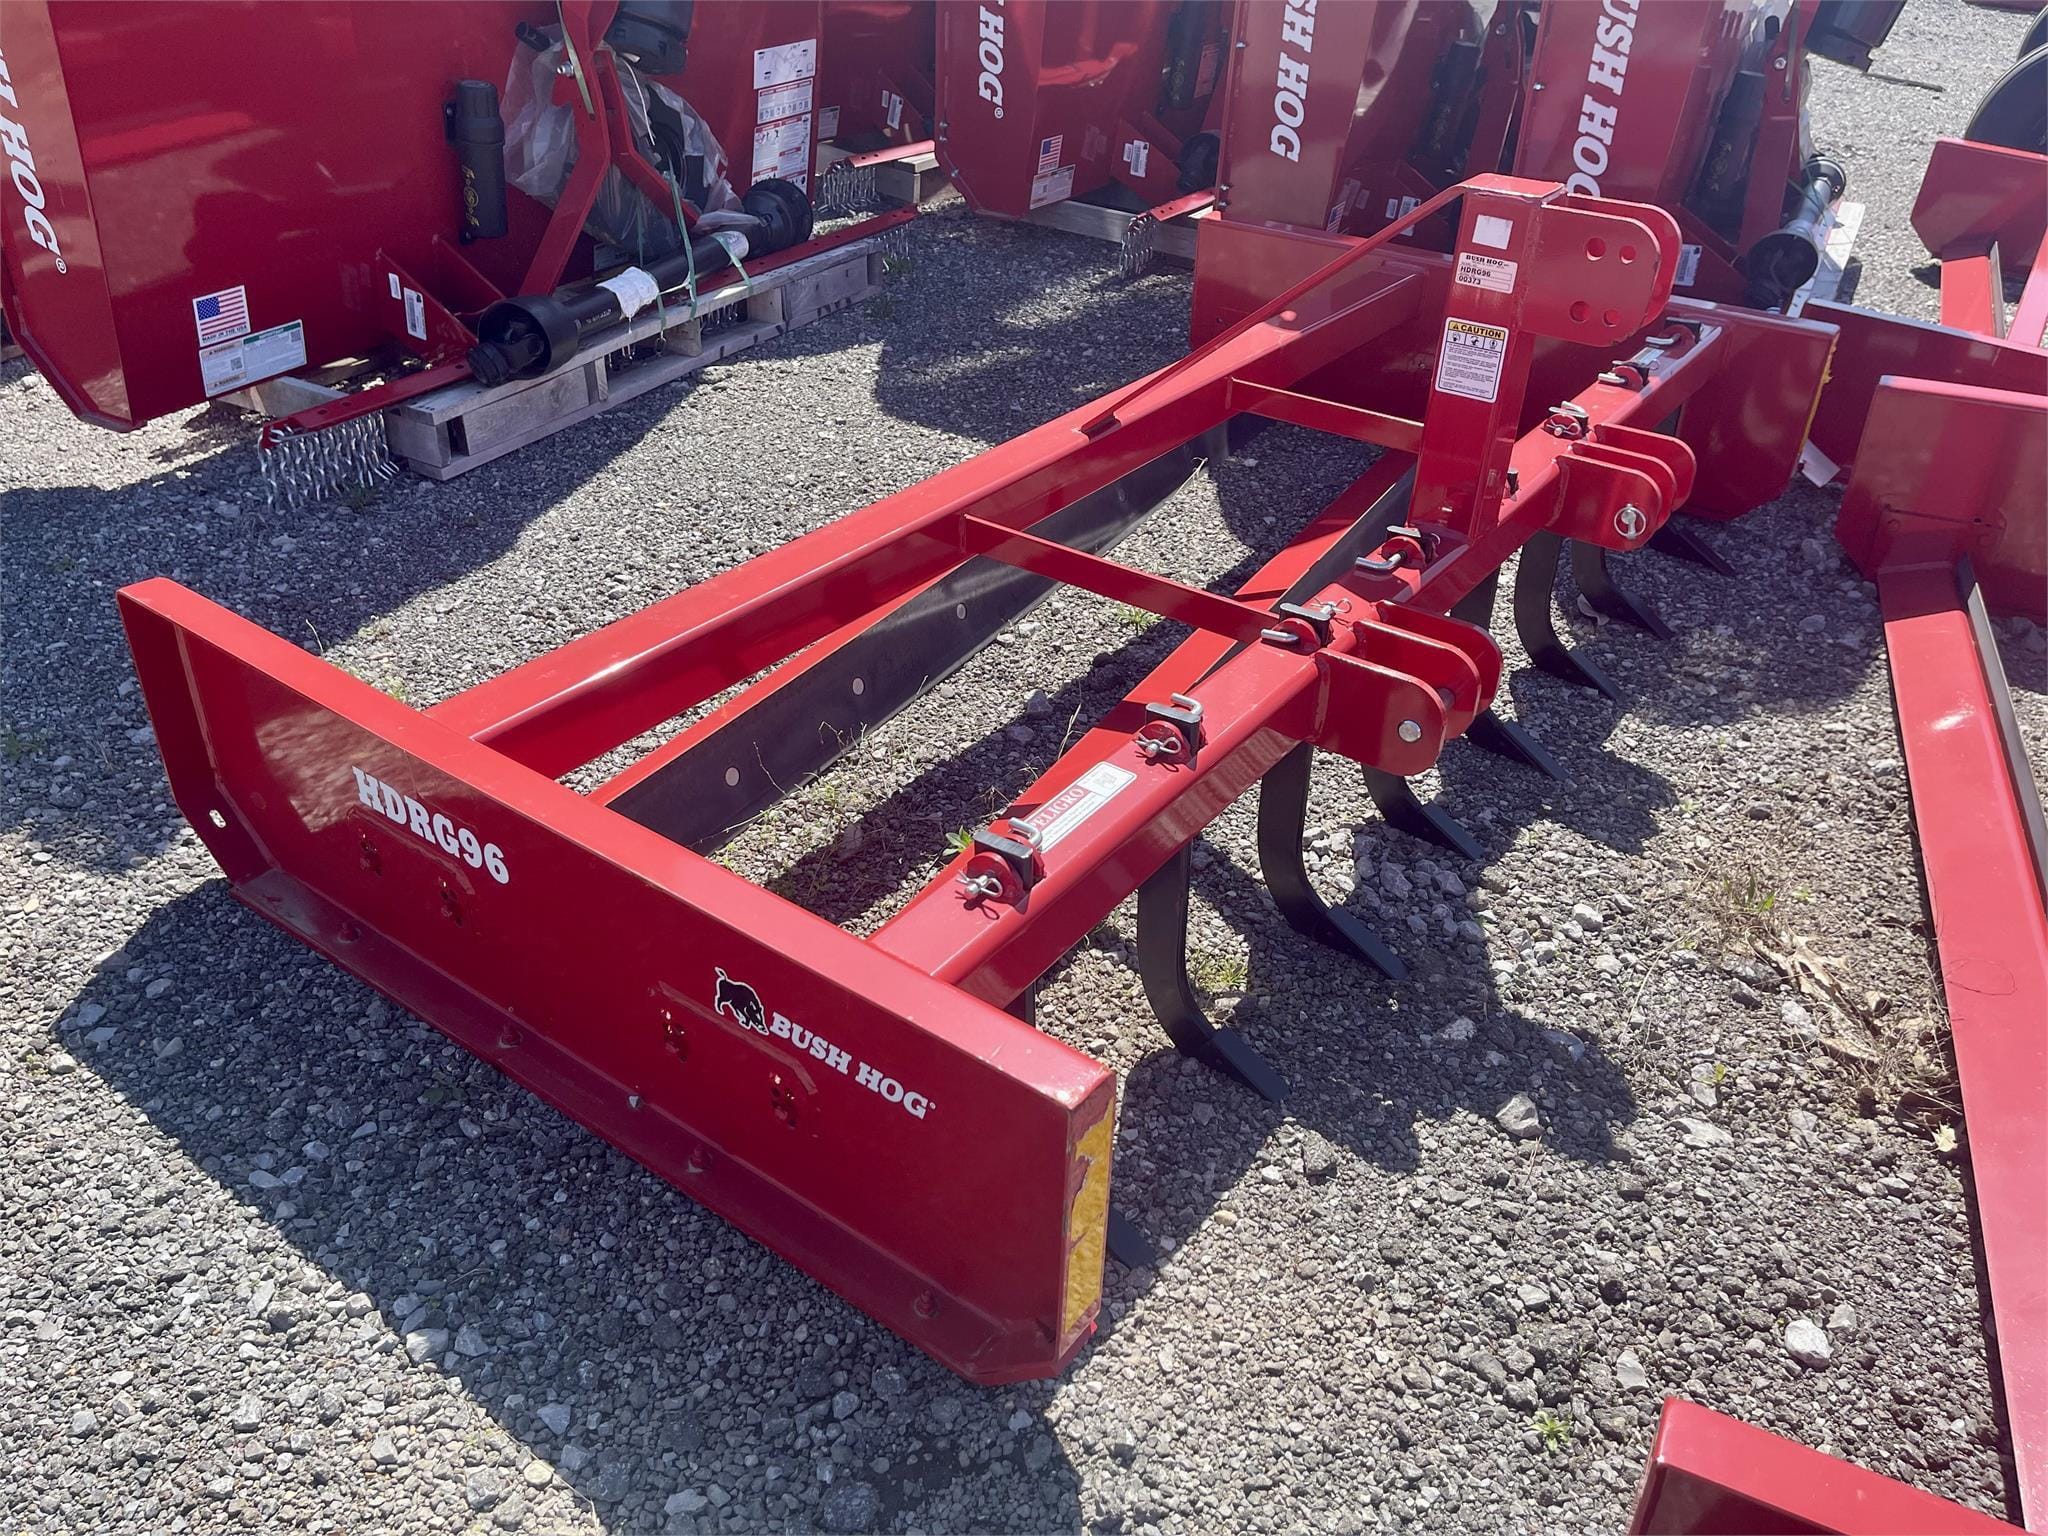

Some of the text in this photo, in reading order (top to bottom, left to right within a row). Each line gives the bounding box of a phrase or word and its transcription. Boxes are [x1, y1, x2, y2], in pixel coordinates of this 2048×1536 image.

[1270, 52, 1309, 162] HOG
[1460, 266, 1491, 277] HDRG96
[1466, 254, 1485, 262] BUSH
[1486, 257, 1504, 266] HOG
[1461, 325, 1501, 338] CAUTION
[352, 765, 510, 885] HDRG96
[770, 1012, 852, 1074] BUSH
